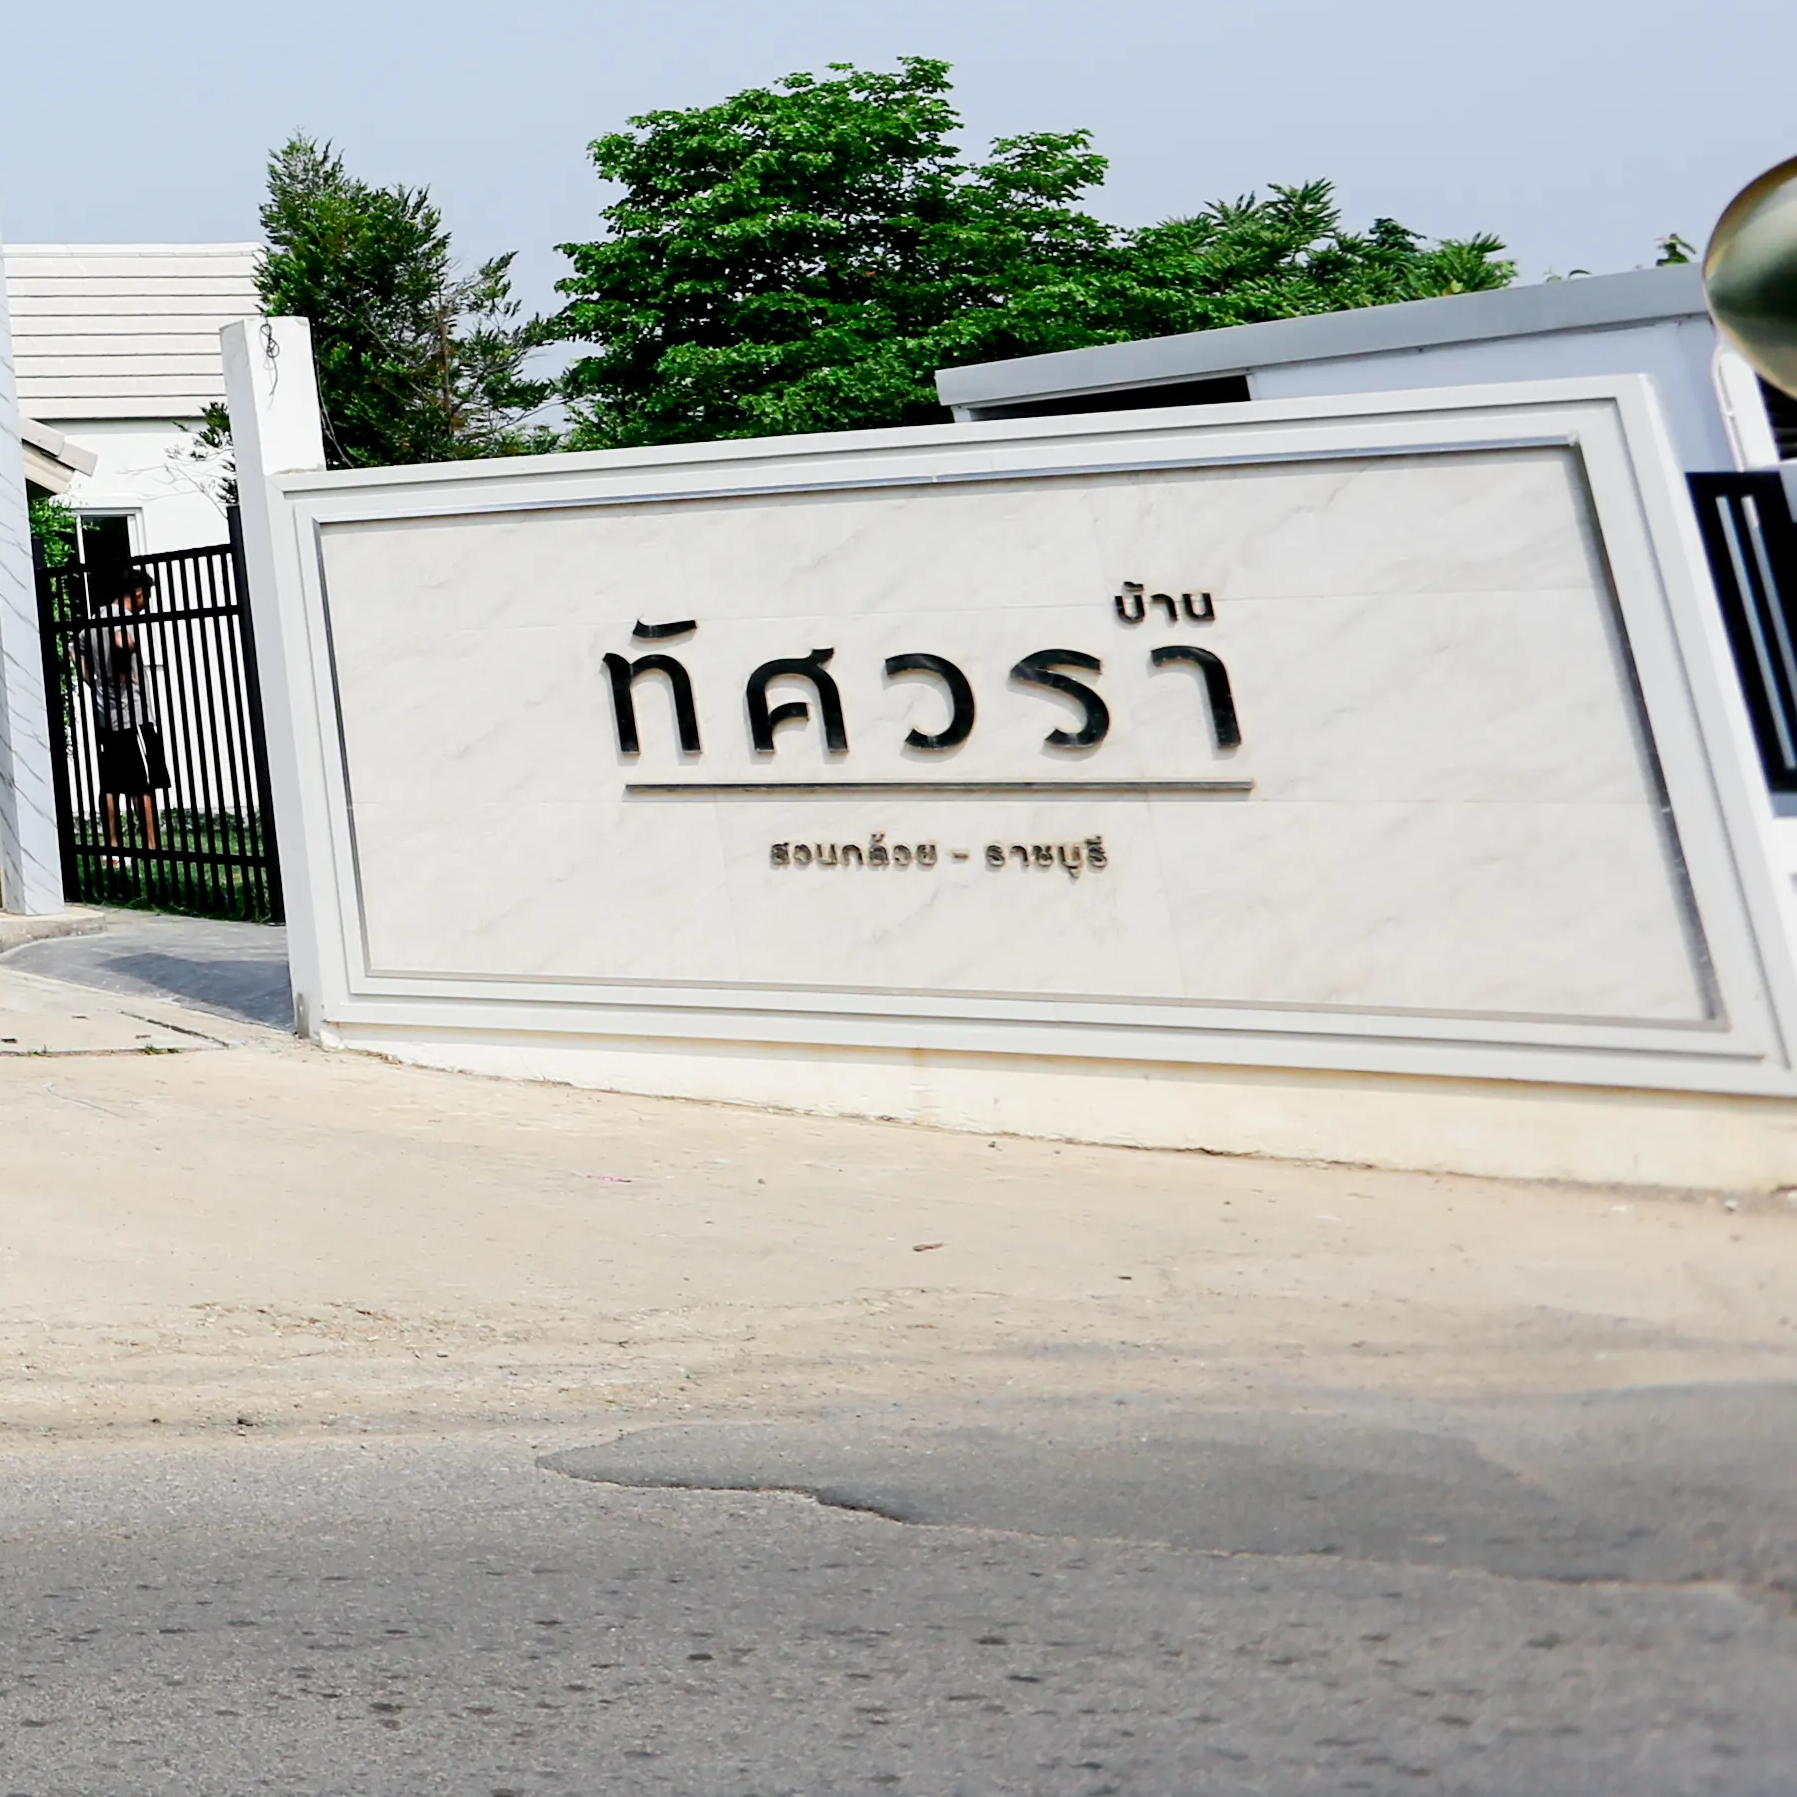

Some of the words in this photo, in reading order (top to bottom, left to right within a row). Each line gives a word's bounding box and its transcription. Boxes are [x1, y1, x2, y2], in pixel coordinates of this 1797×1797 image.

[1113, 580, 1216, 625] บ้าน
[769, 833, 938, 868] สวนกล้วย
[984, 835, 1108, 879] ราชบุรี
